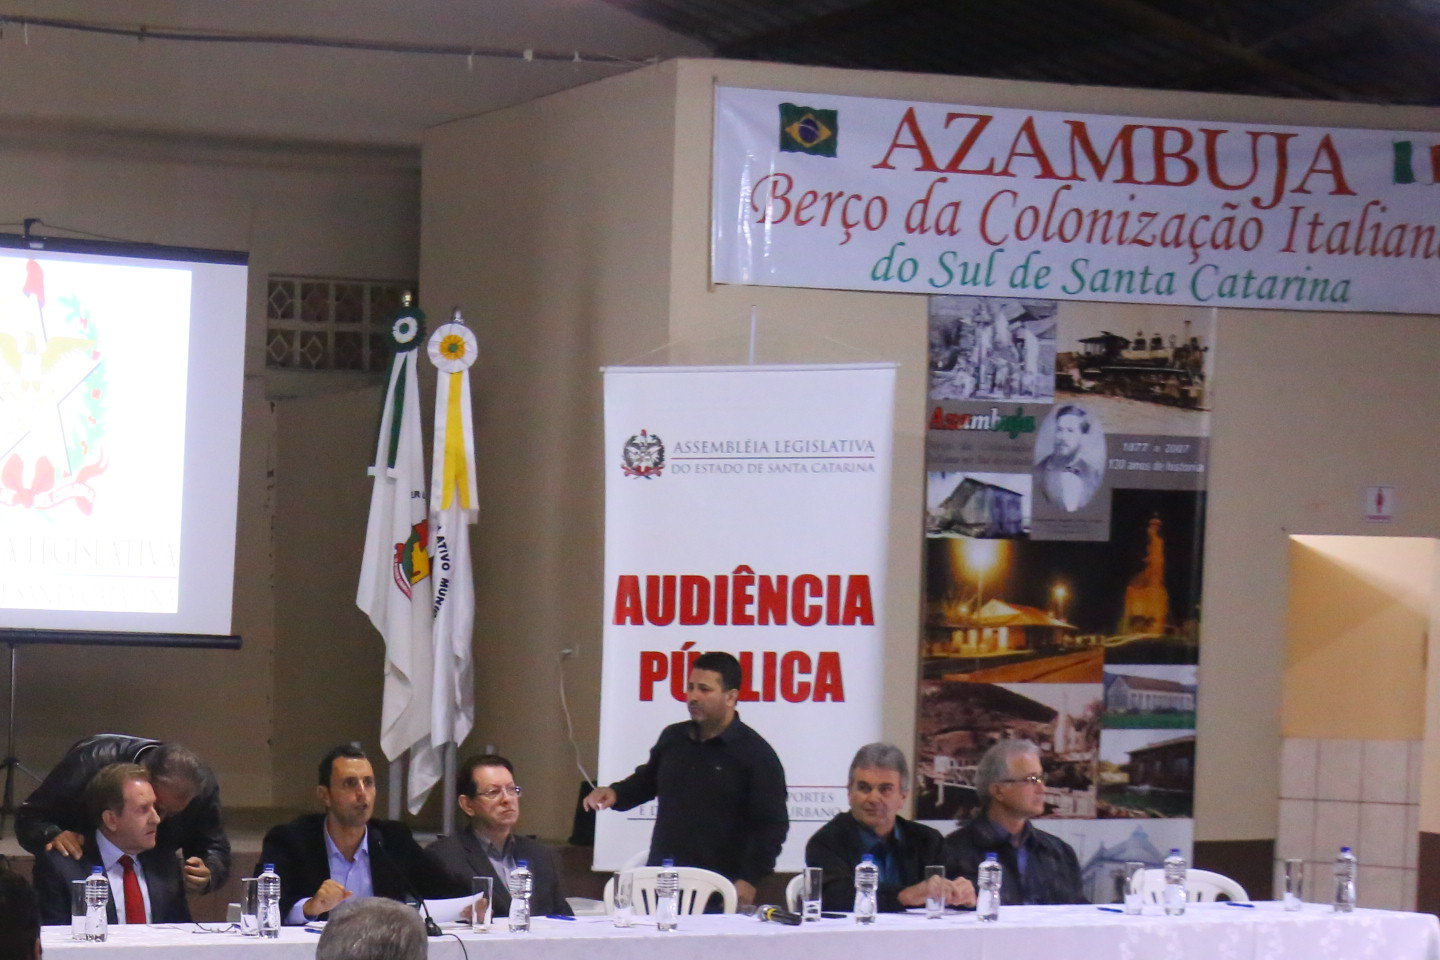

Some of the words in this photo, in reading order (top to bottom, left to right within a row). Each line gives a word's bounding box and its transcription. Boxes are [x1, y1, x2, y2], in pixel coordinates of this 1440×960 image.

[872, 106, 1357, 210] AZAMBUJA
[750, 172, 888, 246] Berço
[904, 176, 962, 237] da
[979, 184, 1264, 265] Colonização
[871, 242, 919, 283] do
[928, 248, 1004, 288] Sul
[1009, 250, 1052, 289] de
[1062, 257, 1177, 296] Santa
[1189, 263, 1352, 304] Catarina
[671, 463, 691, 474] DO
[695, 463, 744, 474] ESTADO
[747, 463, 764, 474] DE
[767, 463, 808, 474] SANTA
[811, 462, 876, 474] CATARINA
[673, 438, 769, 454] ASSEMBLÉIA
[775, 439, 876, 453] LEGISLATIVA
[612, 564, 875, 627] AUDIÊNCIA
[639, 641, 846, 703] PÚLICA
